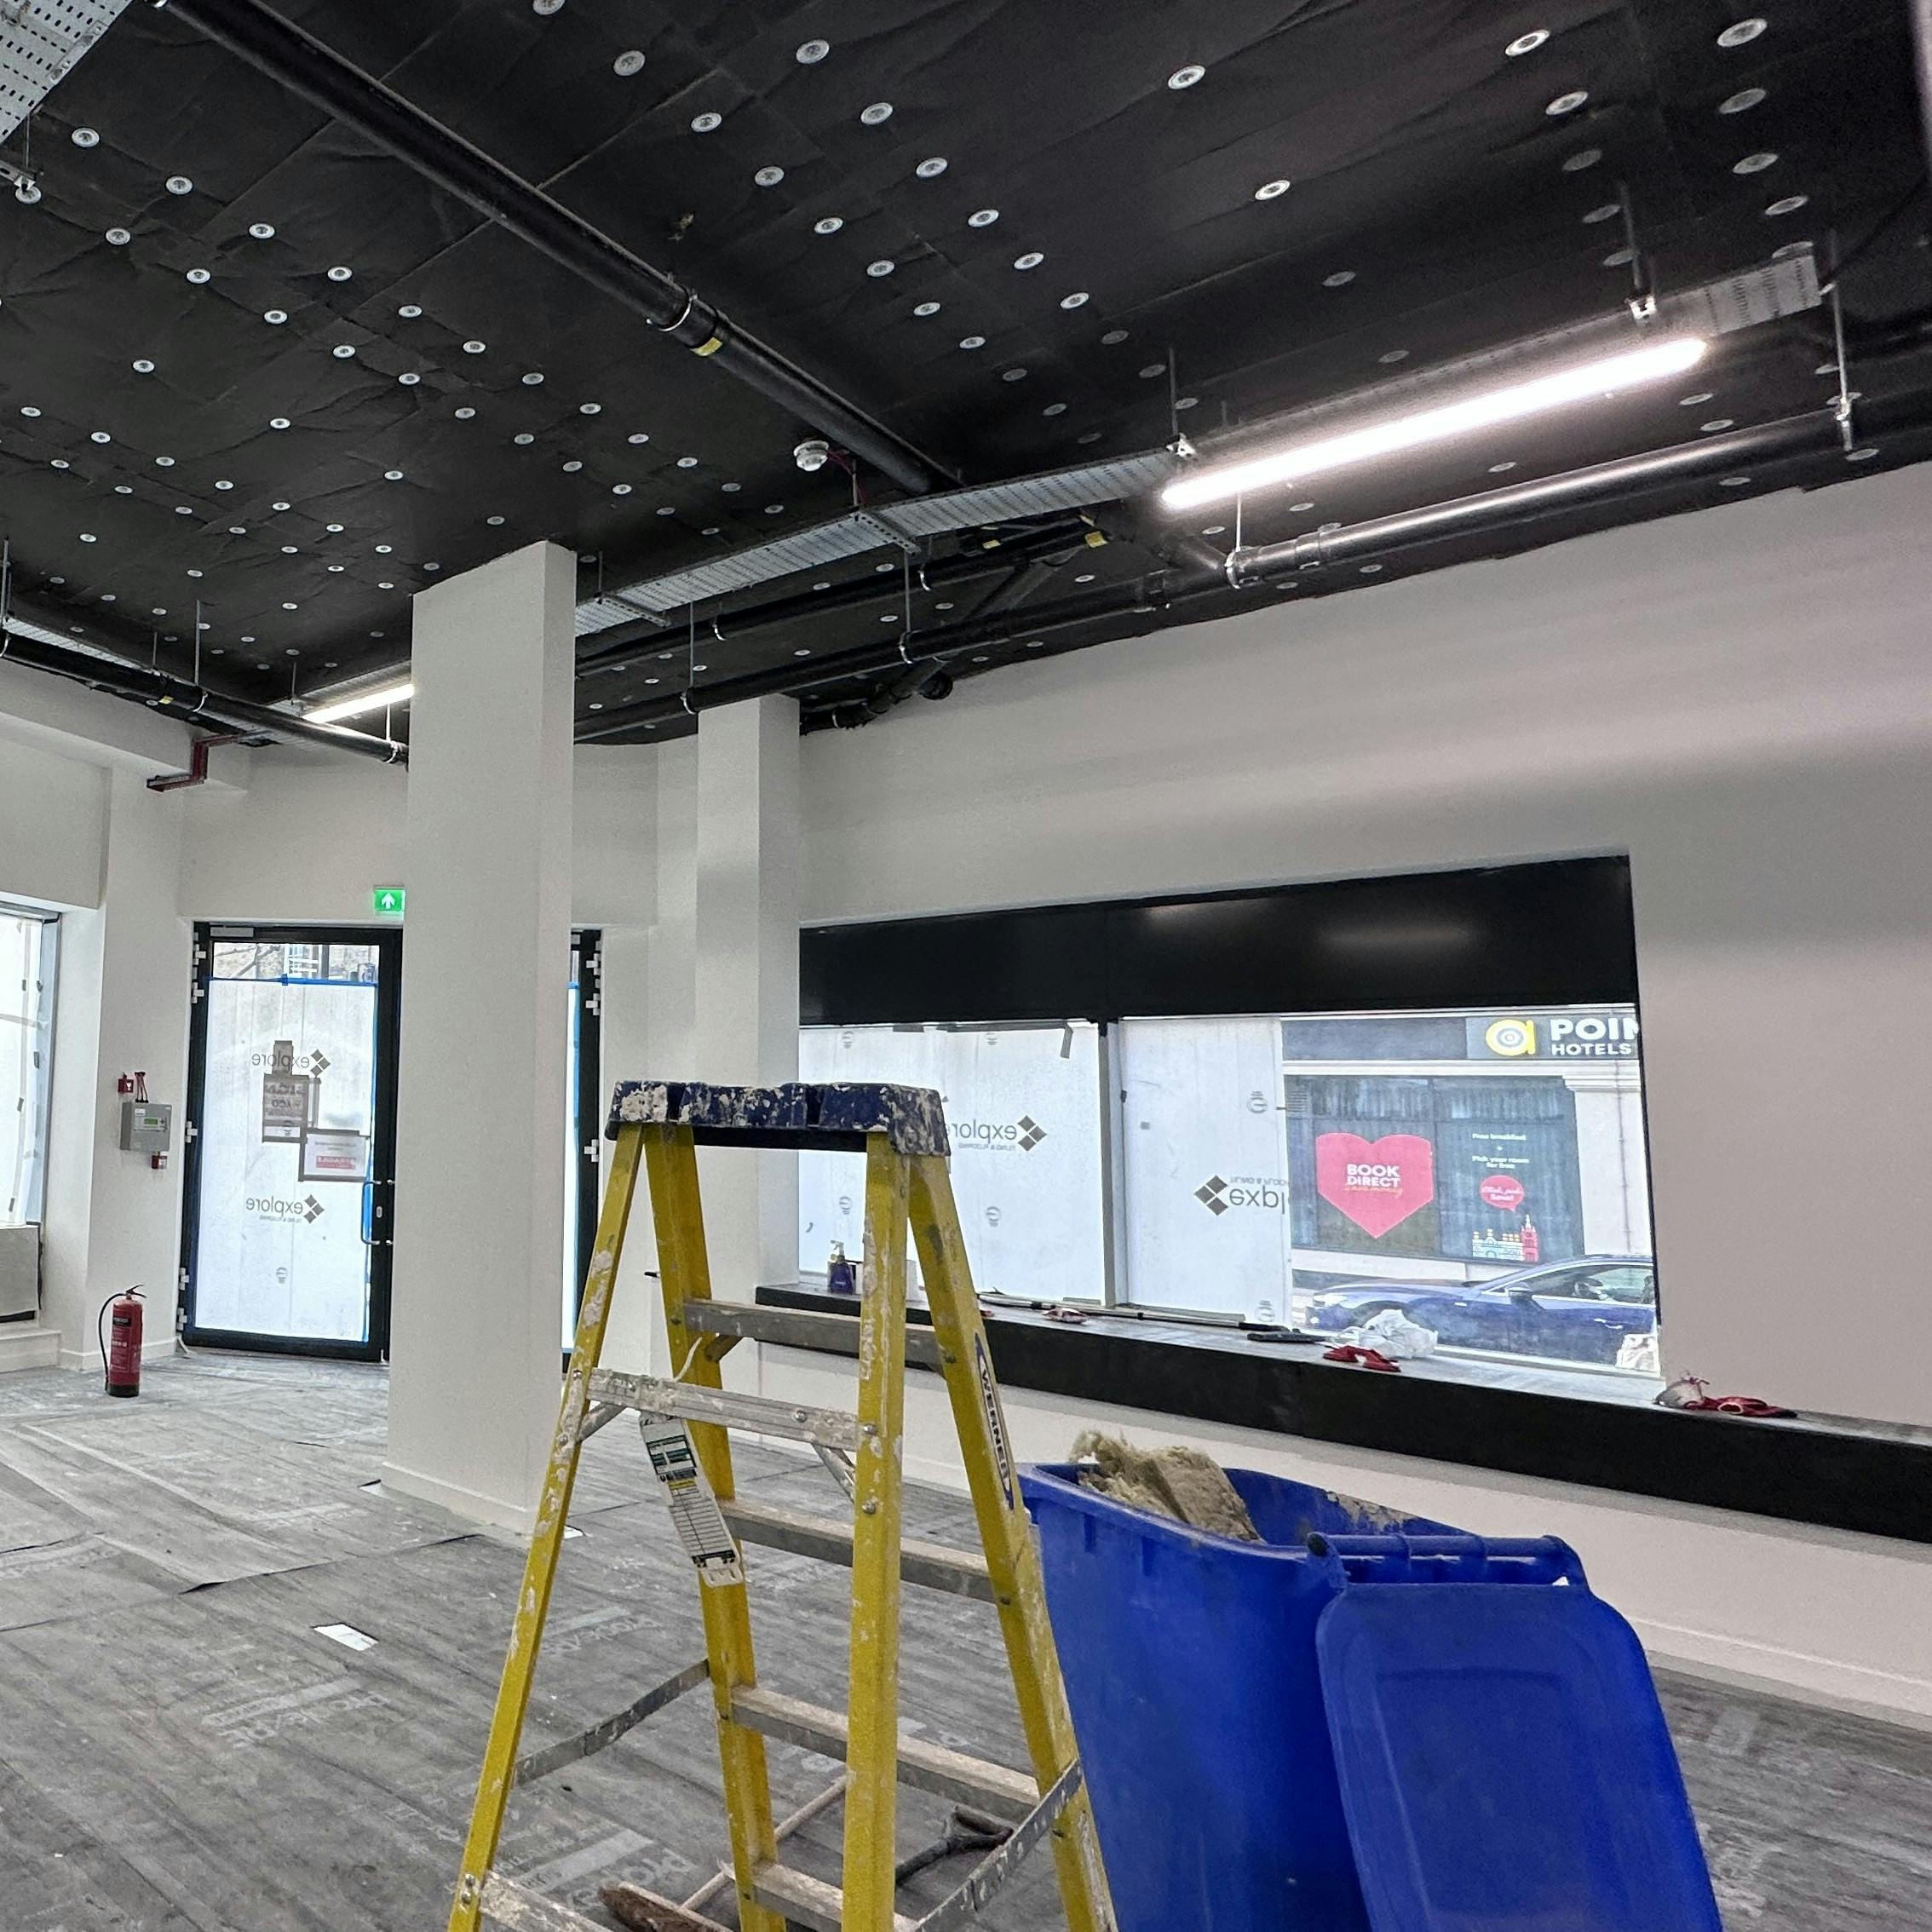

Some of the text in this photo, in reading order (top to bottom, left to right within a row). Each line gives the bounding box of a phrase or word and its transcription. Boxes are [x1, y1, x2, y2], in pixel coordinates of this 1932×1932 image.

[1552, 1044, 1631, 1055] HOTELS
[1347, 1164, 1400, 1177] BOOK
[1347, 1176, 1401, 1187] DIRECT
[981, 1369, 1008, 1479] WERNER
